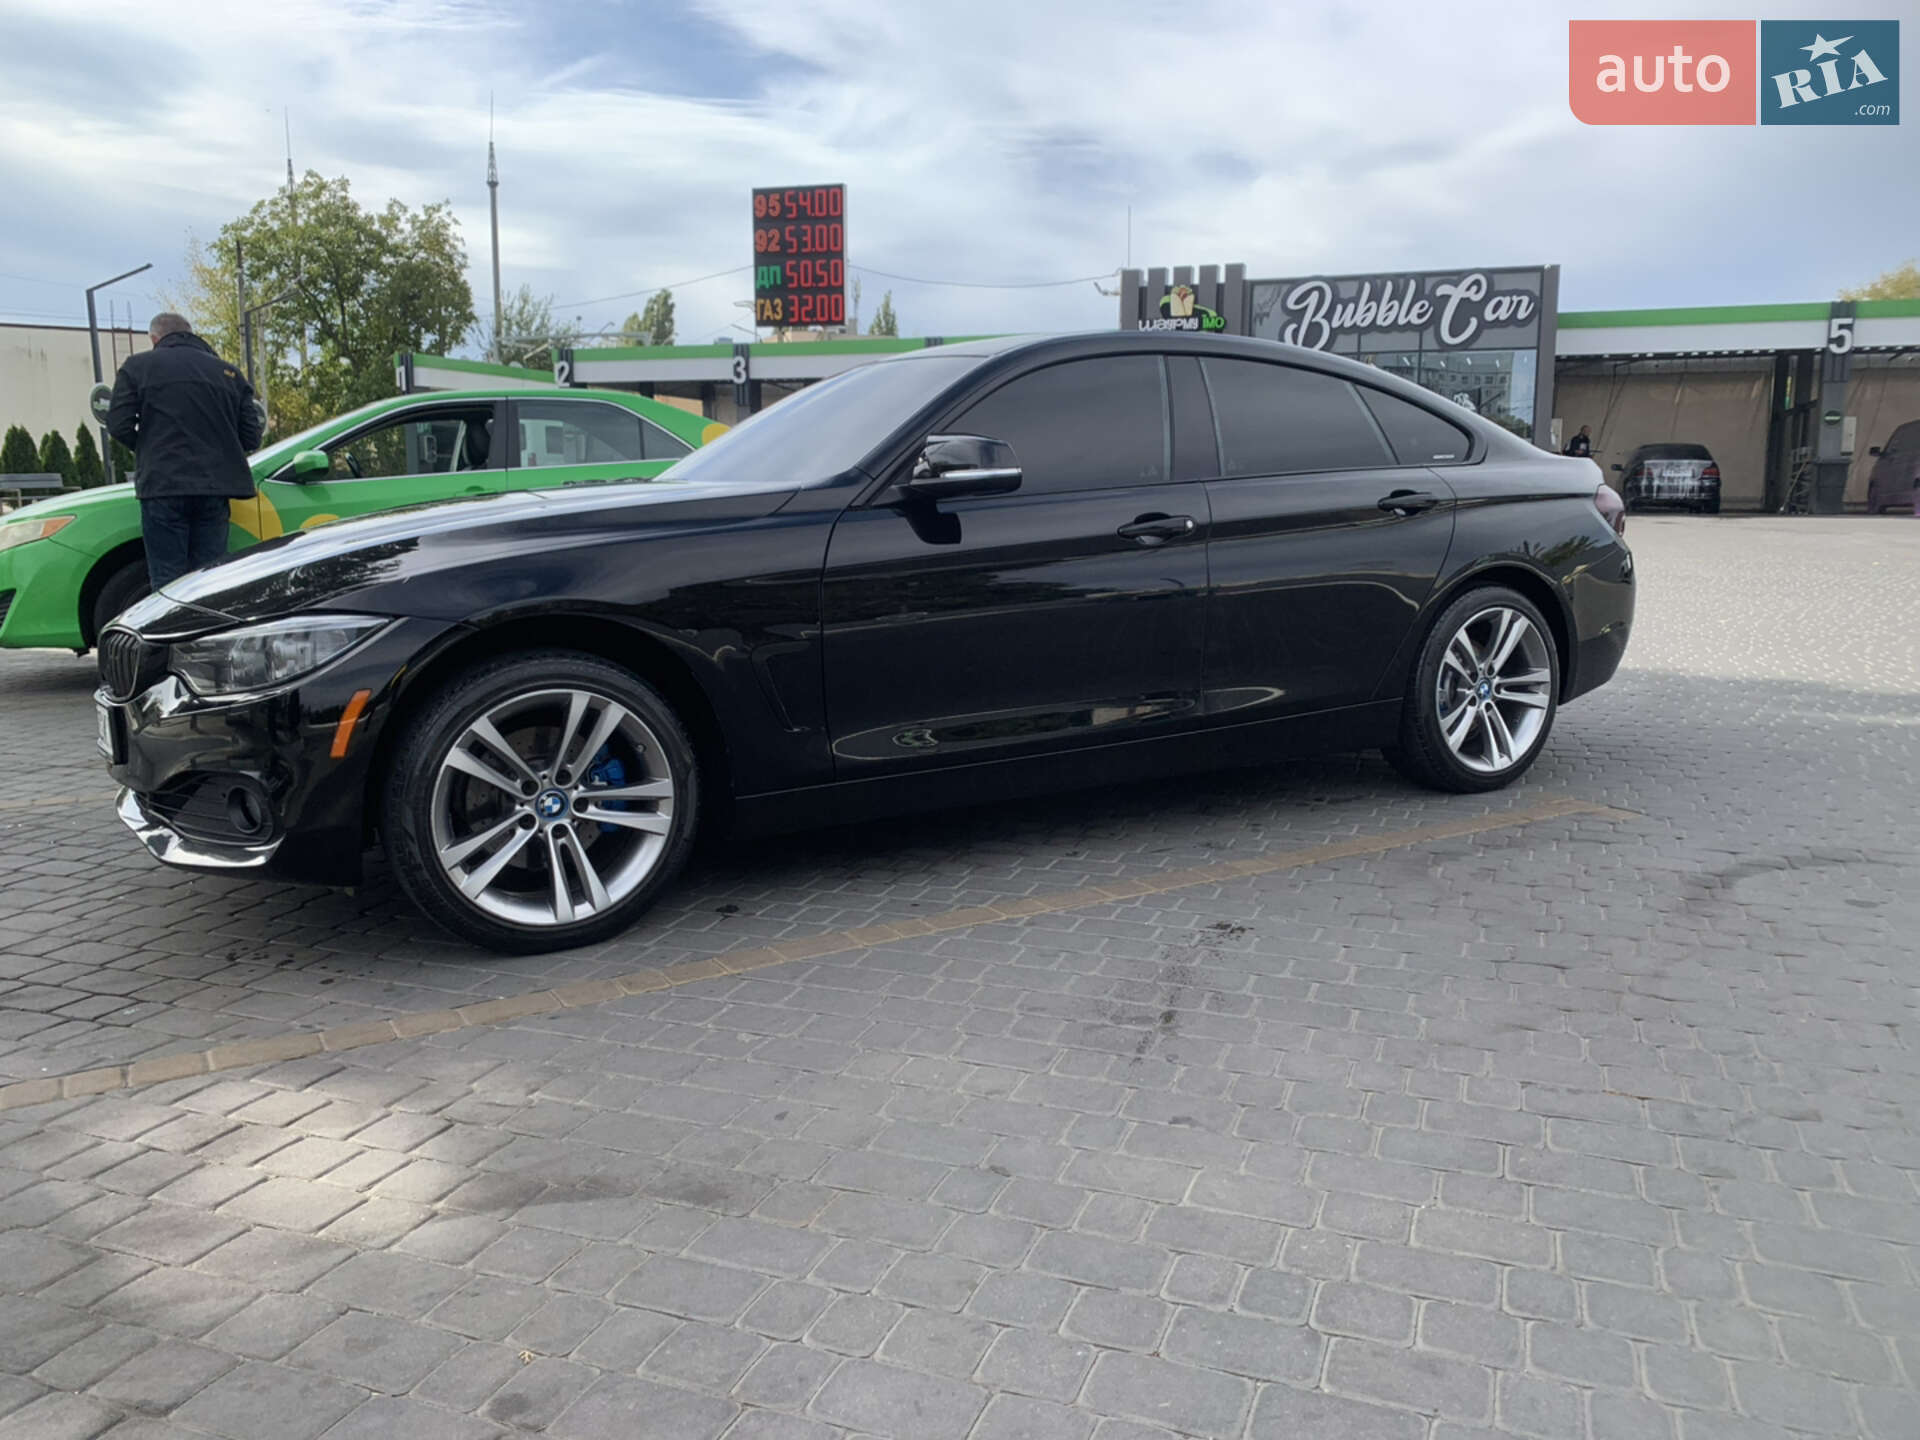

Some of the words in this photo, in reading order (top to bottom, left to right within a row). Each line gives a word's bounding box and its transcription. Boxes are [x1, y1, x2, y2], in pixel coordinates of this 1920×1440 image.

[754, 193, 781, 218] 95
[785, 188, 842, 218] 54.00
[755, 228, 781, 253] 92
[785, 224, 843, 253] 53.00
[756, 265, 781, 288] ДП
[786, 259, 843, 288] 50.50
[756, 297, 783, 321] ГАЗ
[788, 294, 843, 322] 32.00
[1283, 278, 1433, 350] Bubble
[1435, 273, 1535, 345] Car
[1829, 318, 1853, 354] 5
[557, 361, 570, 387] 2
[733, 356, 747, 384] 3
